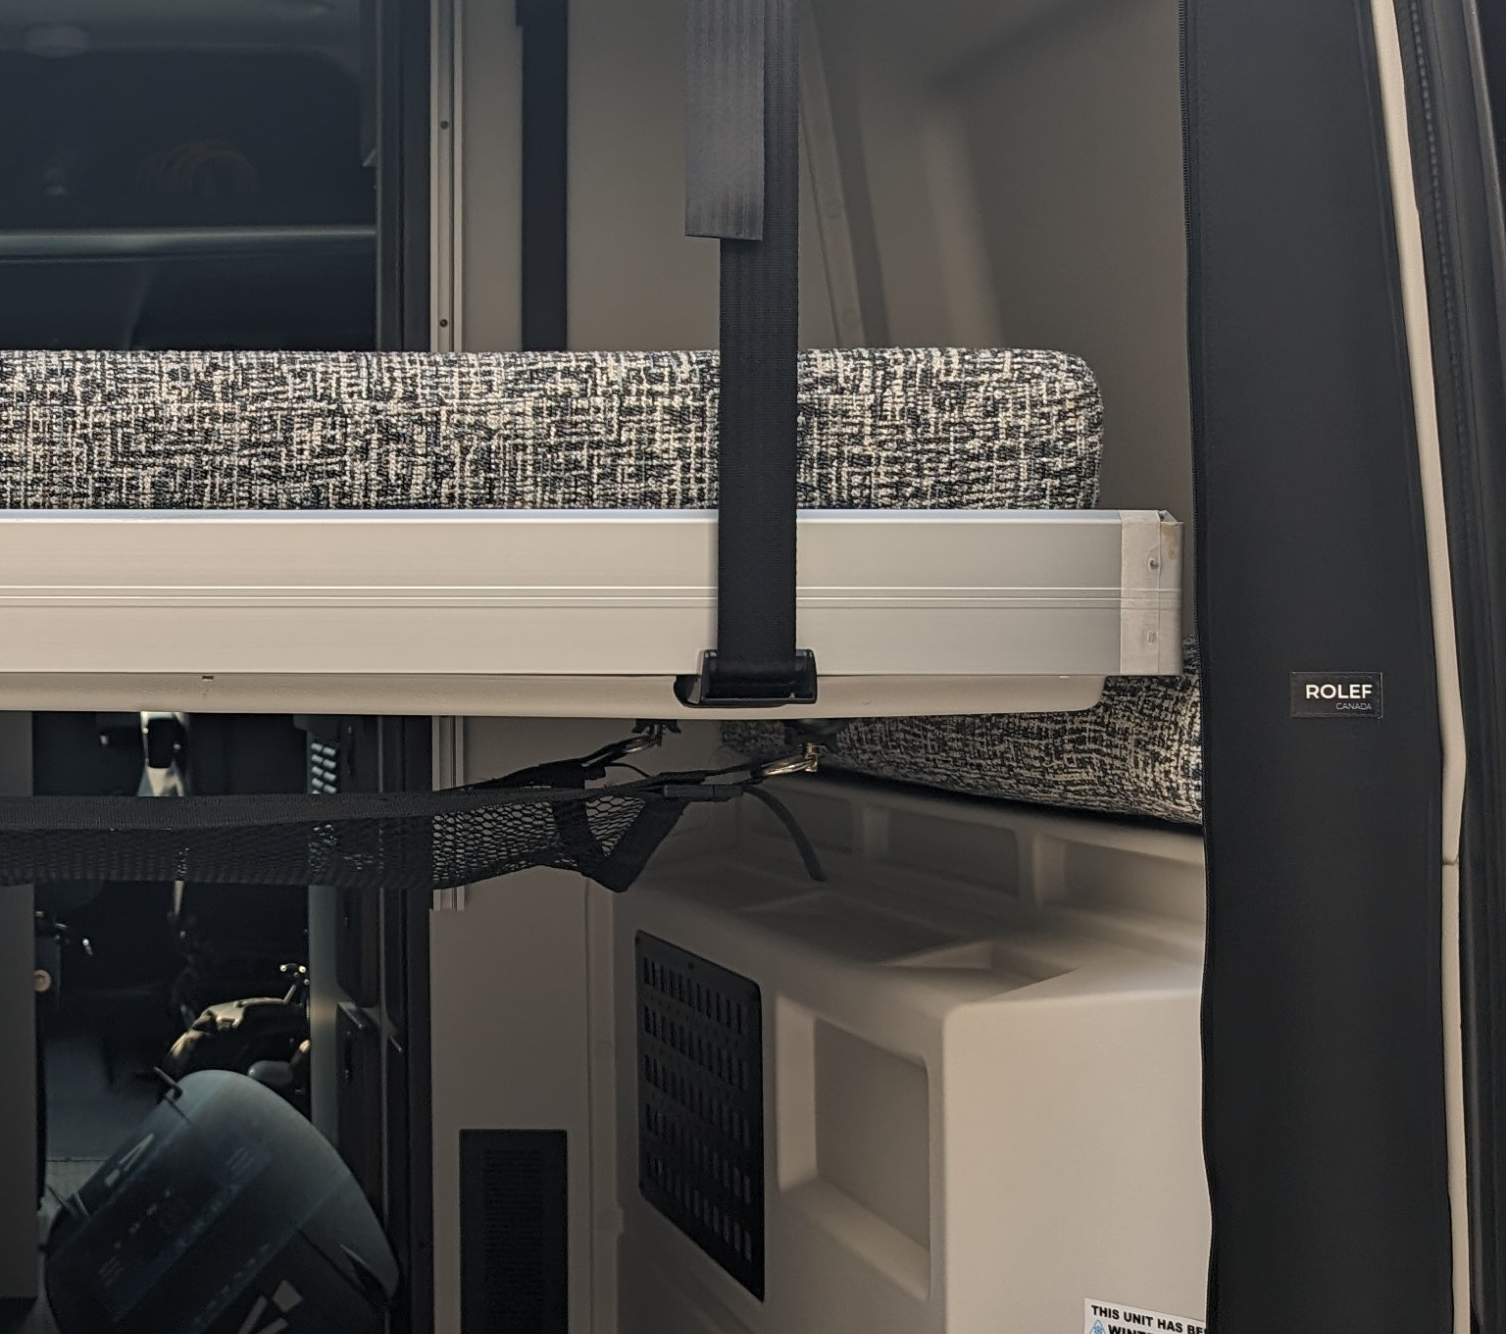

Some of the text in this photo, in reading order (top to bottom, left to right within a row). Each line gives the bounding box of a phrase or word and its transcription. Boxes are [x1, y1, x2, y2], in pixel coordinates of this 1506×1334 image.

[1305, 684, 1373, 699] ROLEF
[1335, 702, 1373, 710] CANADA
[1091, 1304, 1120, 1320] THIS
[1123, 1311, 1154, 1327] UNIT
[1157, 1318, 1183, 1334] HAS
